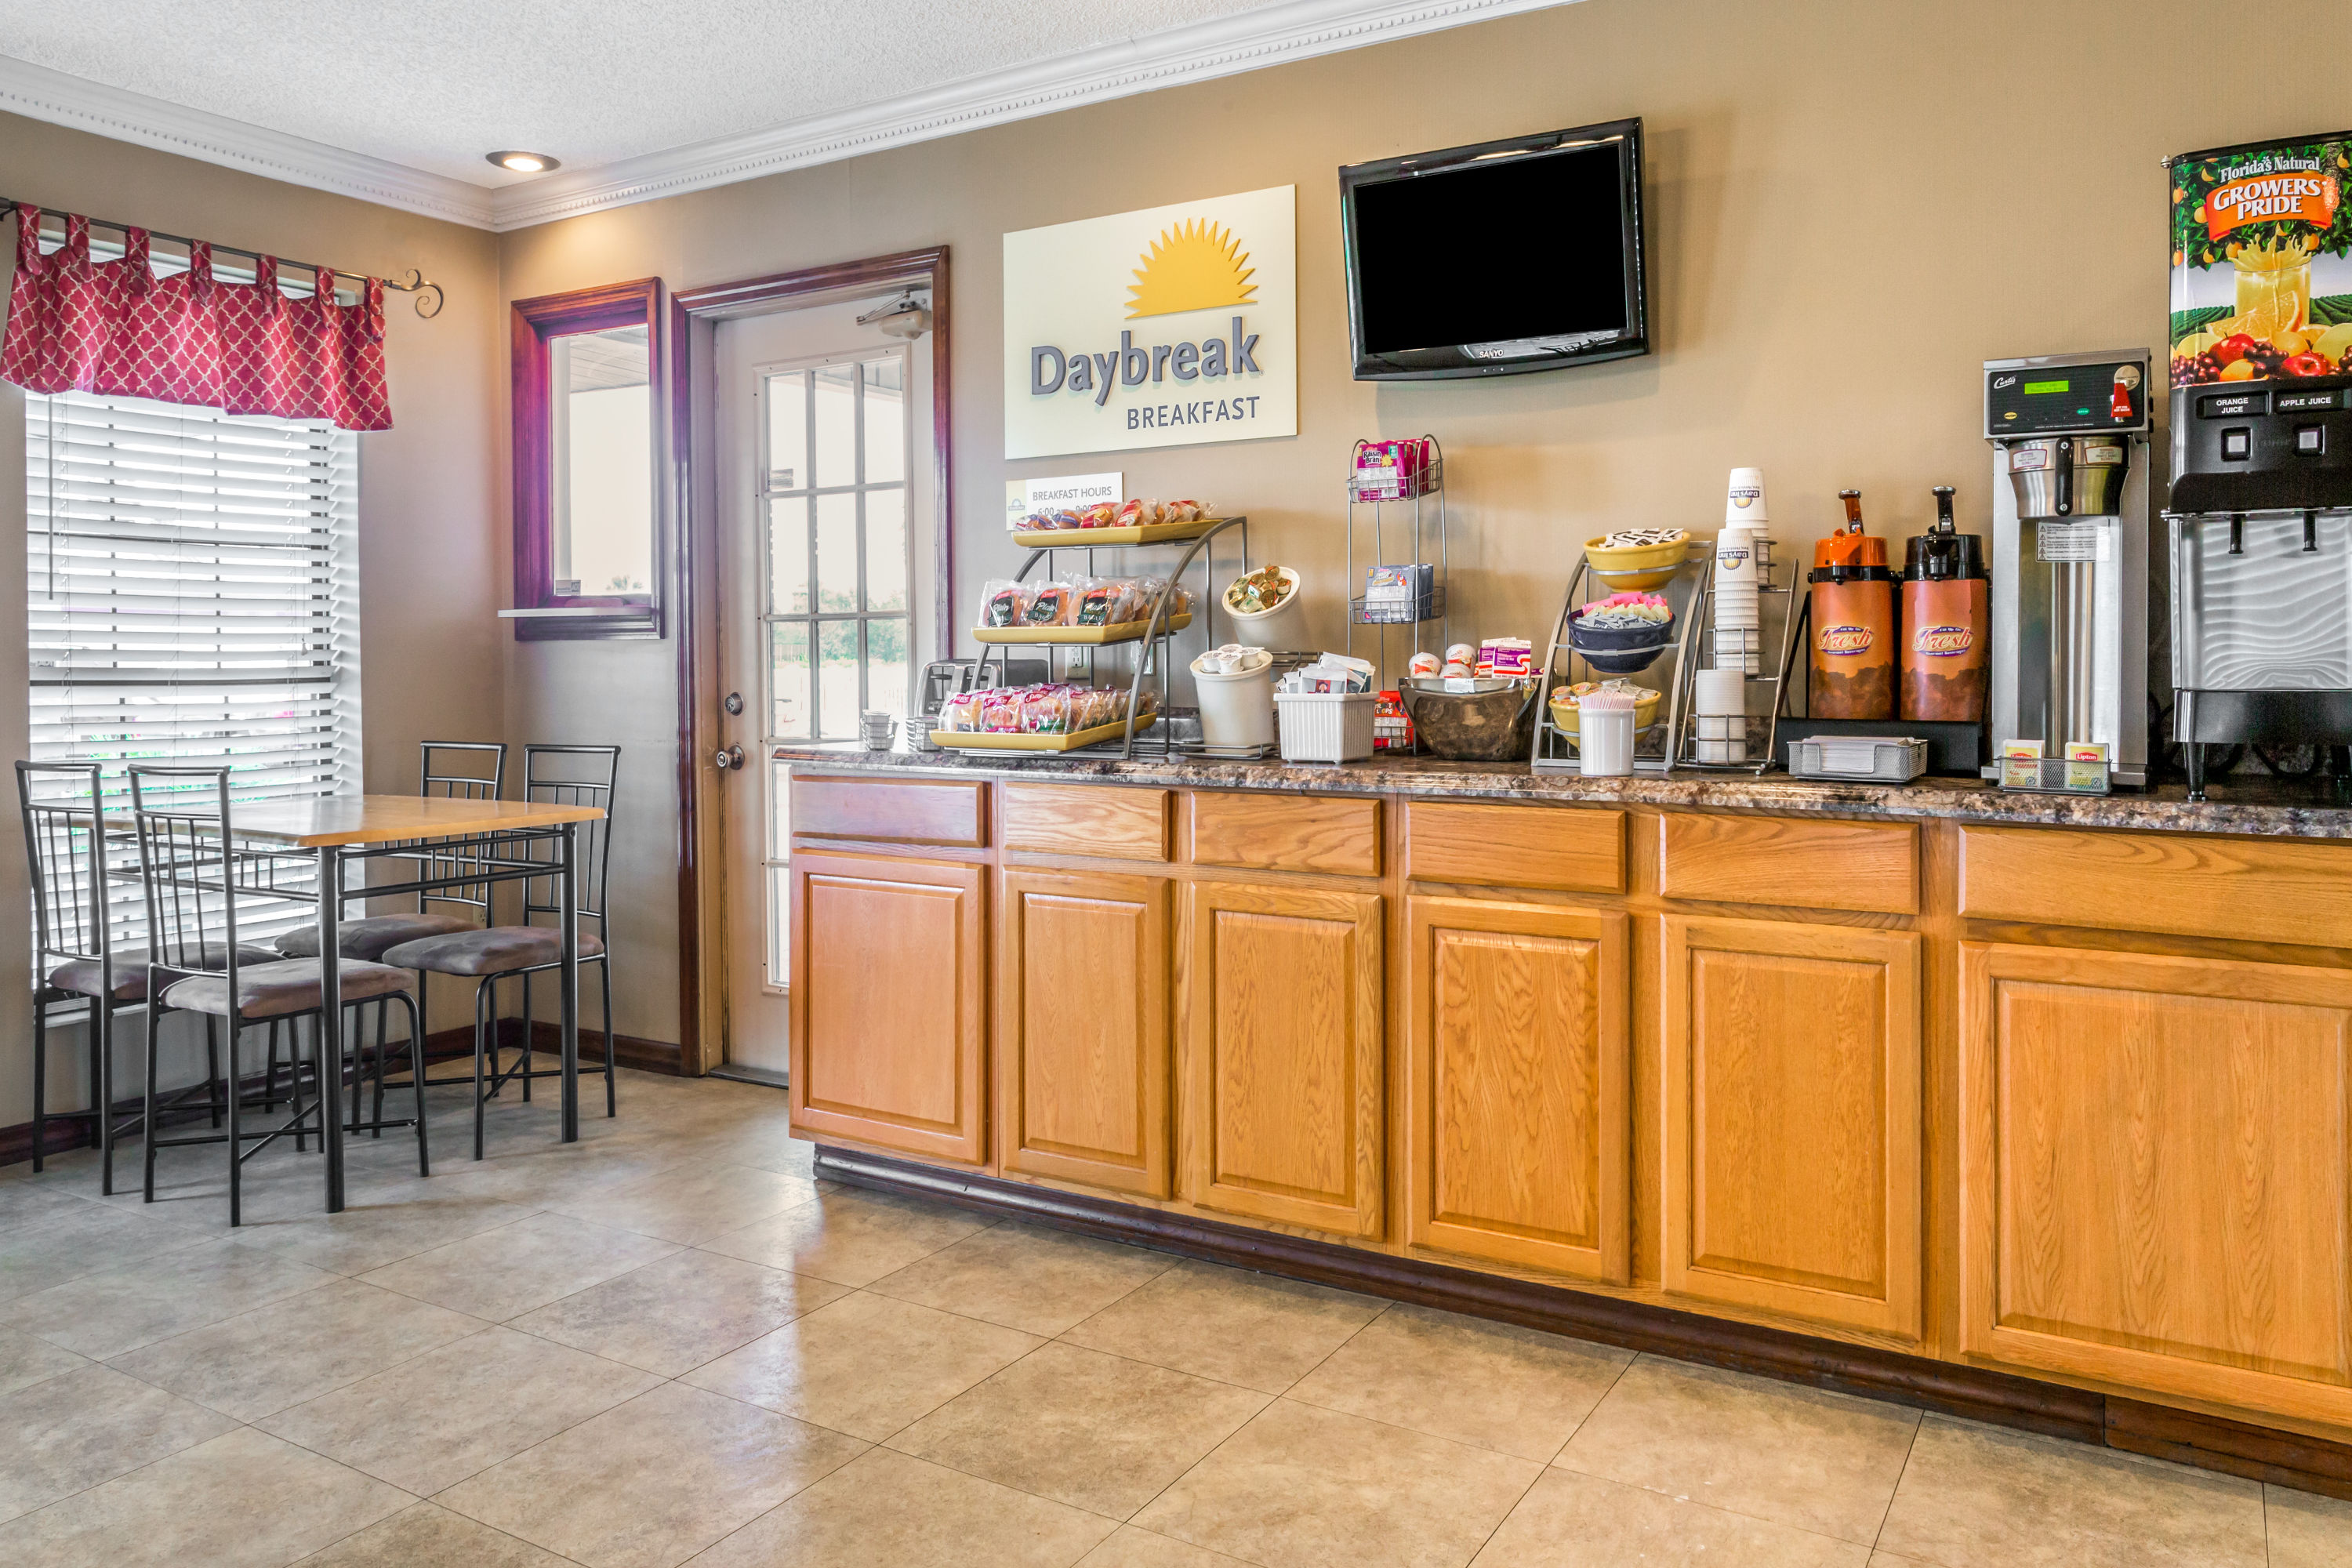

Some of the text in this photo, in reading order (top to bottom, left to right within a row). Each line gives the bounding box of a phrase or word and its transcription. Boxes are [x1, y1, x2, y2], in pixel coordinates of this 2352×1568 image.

[2220, 157, 2320, 183] Florida's Natural
[2213, 178, 2321, 211] GROWERS
[2238, 196, 2303, 220] PRIDE
[1031, 316, 1261, 407] Daybreak
[1479, 349, 1504, 358] SANYO
[1994, 376, 2016, 389] Curtis
[2216, 397, 2249, 406] ORANGE
[2280, 397, 2332, 407] APPLE JUICE
[1127, 396, 1260, 430] BREAKFAST
[1033, 486, 1112, 501] BREAKFAST HOURS
[1038, 507, 1054, 517] 6:00
[1036, 601, 1055, 612] Plain
[1817, 626, 1874, 650] Fresh
[1912, 625, 1973, 652] Fresh
